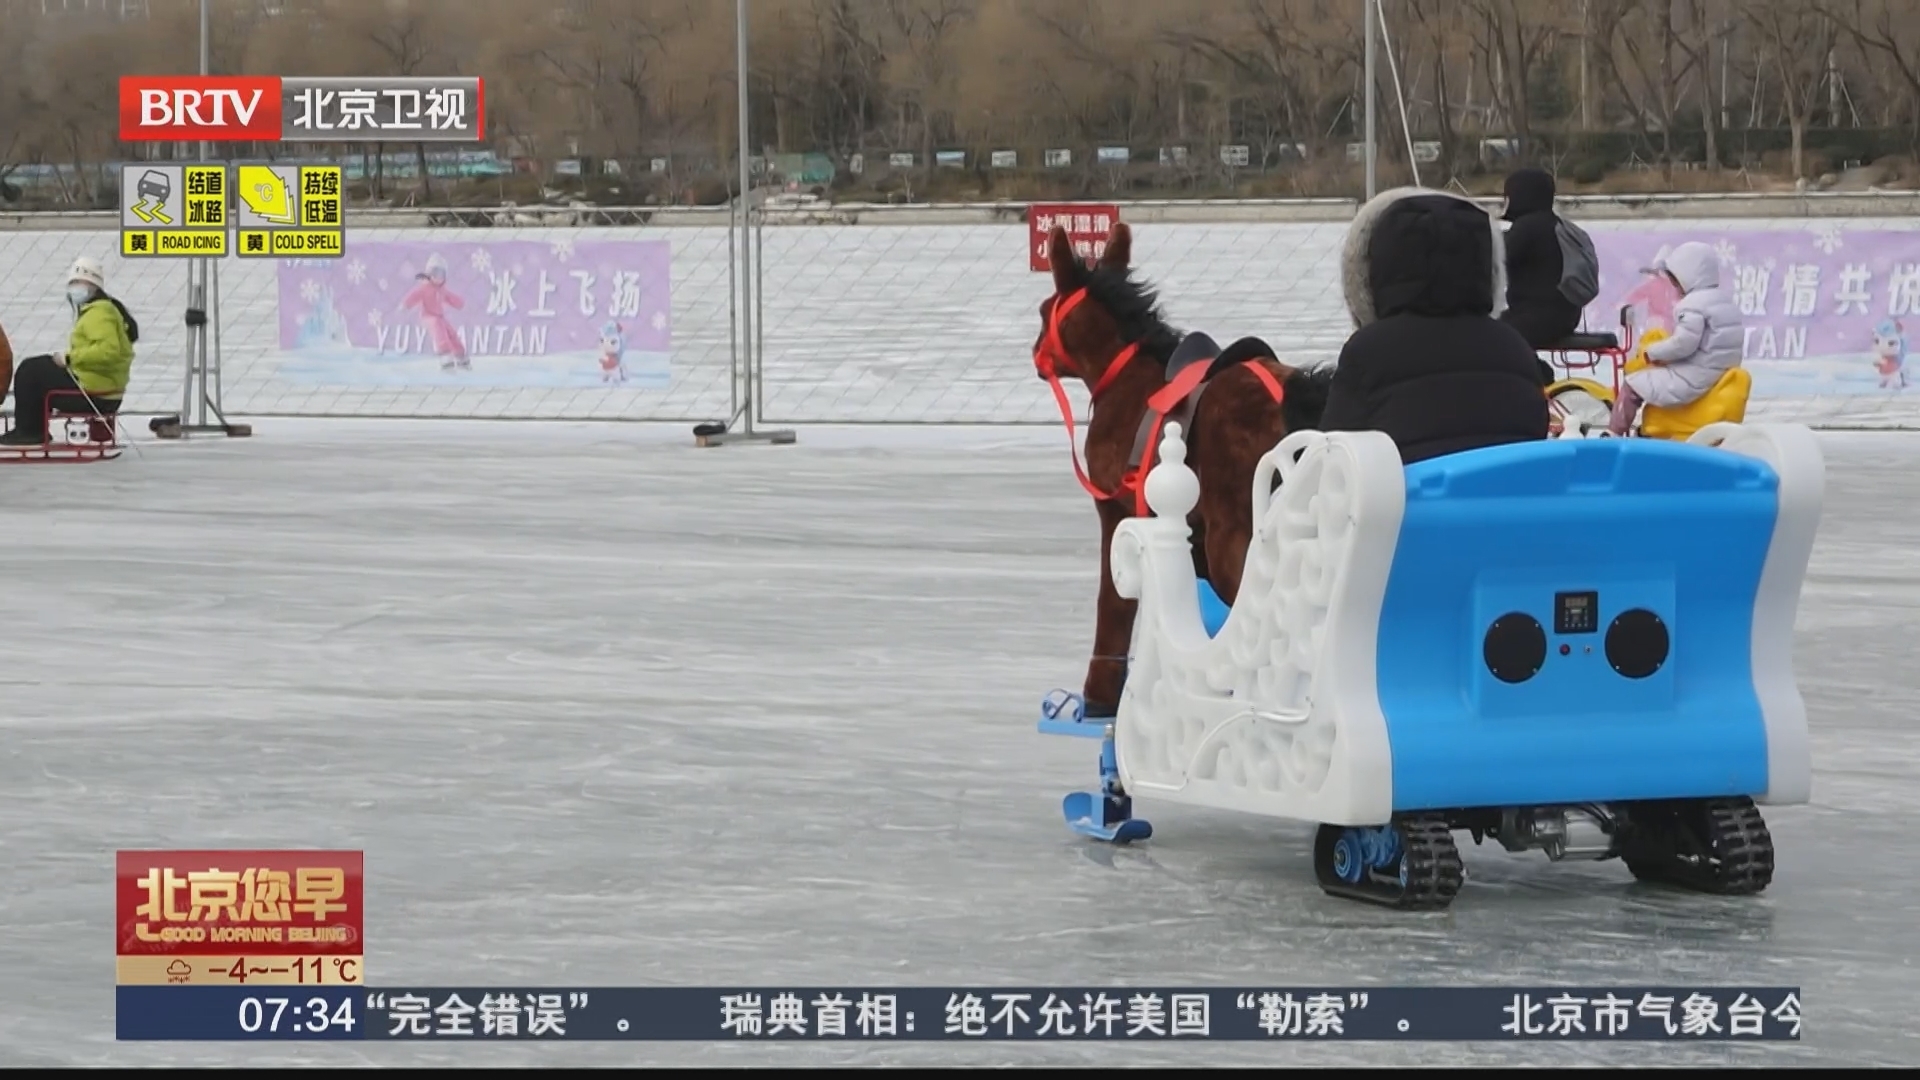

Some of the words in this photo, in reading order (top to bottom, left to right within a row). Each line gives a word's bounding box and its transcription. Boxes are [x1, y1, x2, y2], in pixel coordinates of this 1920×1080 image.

[487, 270, 640, 317] 冰上飞扬
[1733, 263, 1920, 316] 激情共悦
[376, 325, 548, 354] YUYANTAN
